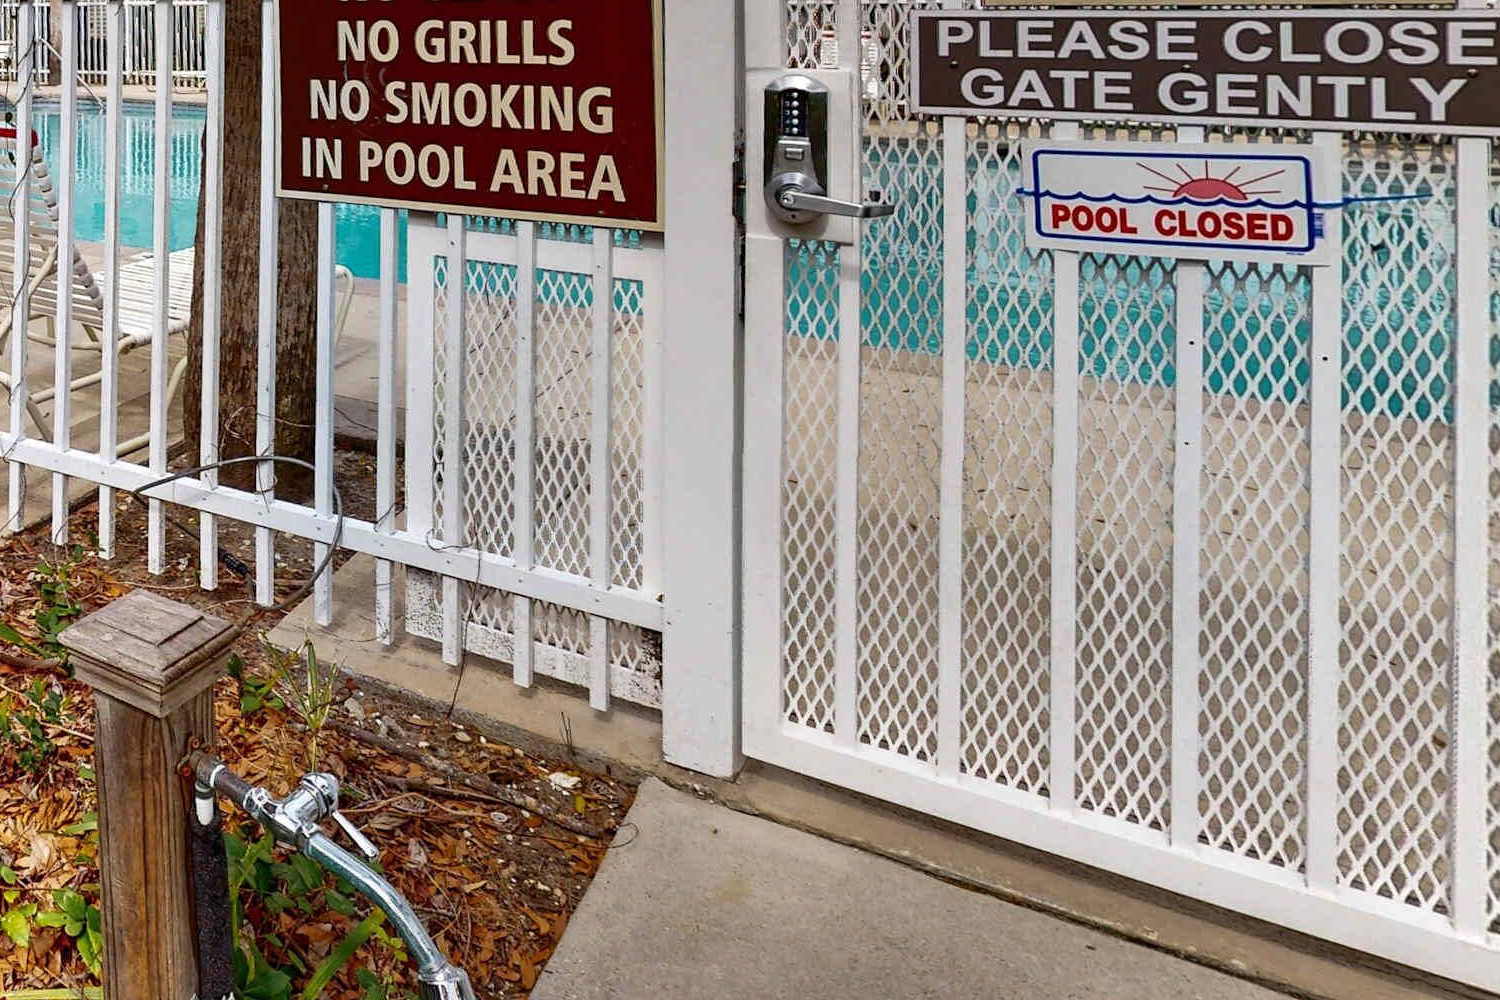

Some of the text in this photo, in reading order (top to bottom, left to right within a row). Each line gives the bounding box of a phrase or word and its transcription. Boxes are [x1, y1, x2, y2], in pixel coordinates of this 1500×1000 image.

[338, 20, 574, 65] NO GRILLS
[939, 21, 1497, 65] PLEASE CLOSE
[311, 80, 612, 133] NO SMOKING
[961, 69, 1467, 121] GATE GENTLY
[303, 137, 625, 202] IN POOL AREA
[1052, 204, 1136, 233] POOL
[1155, 210, 1293, 241] CLOSED
